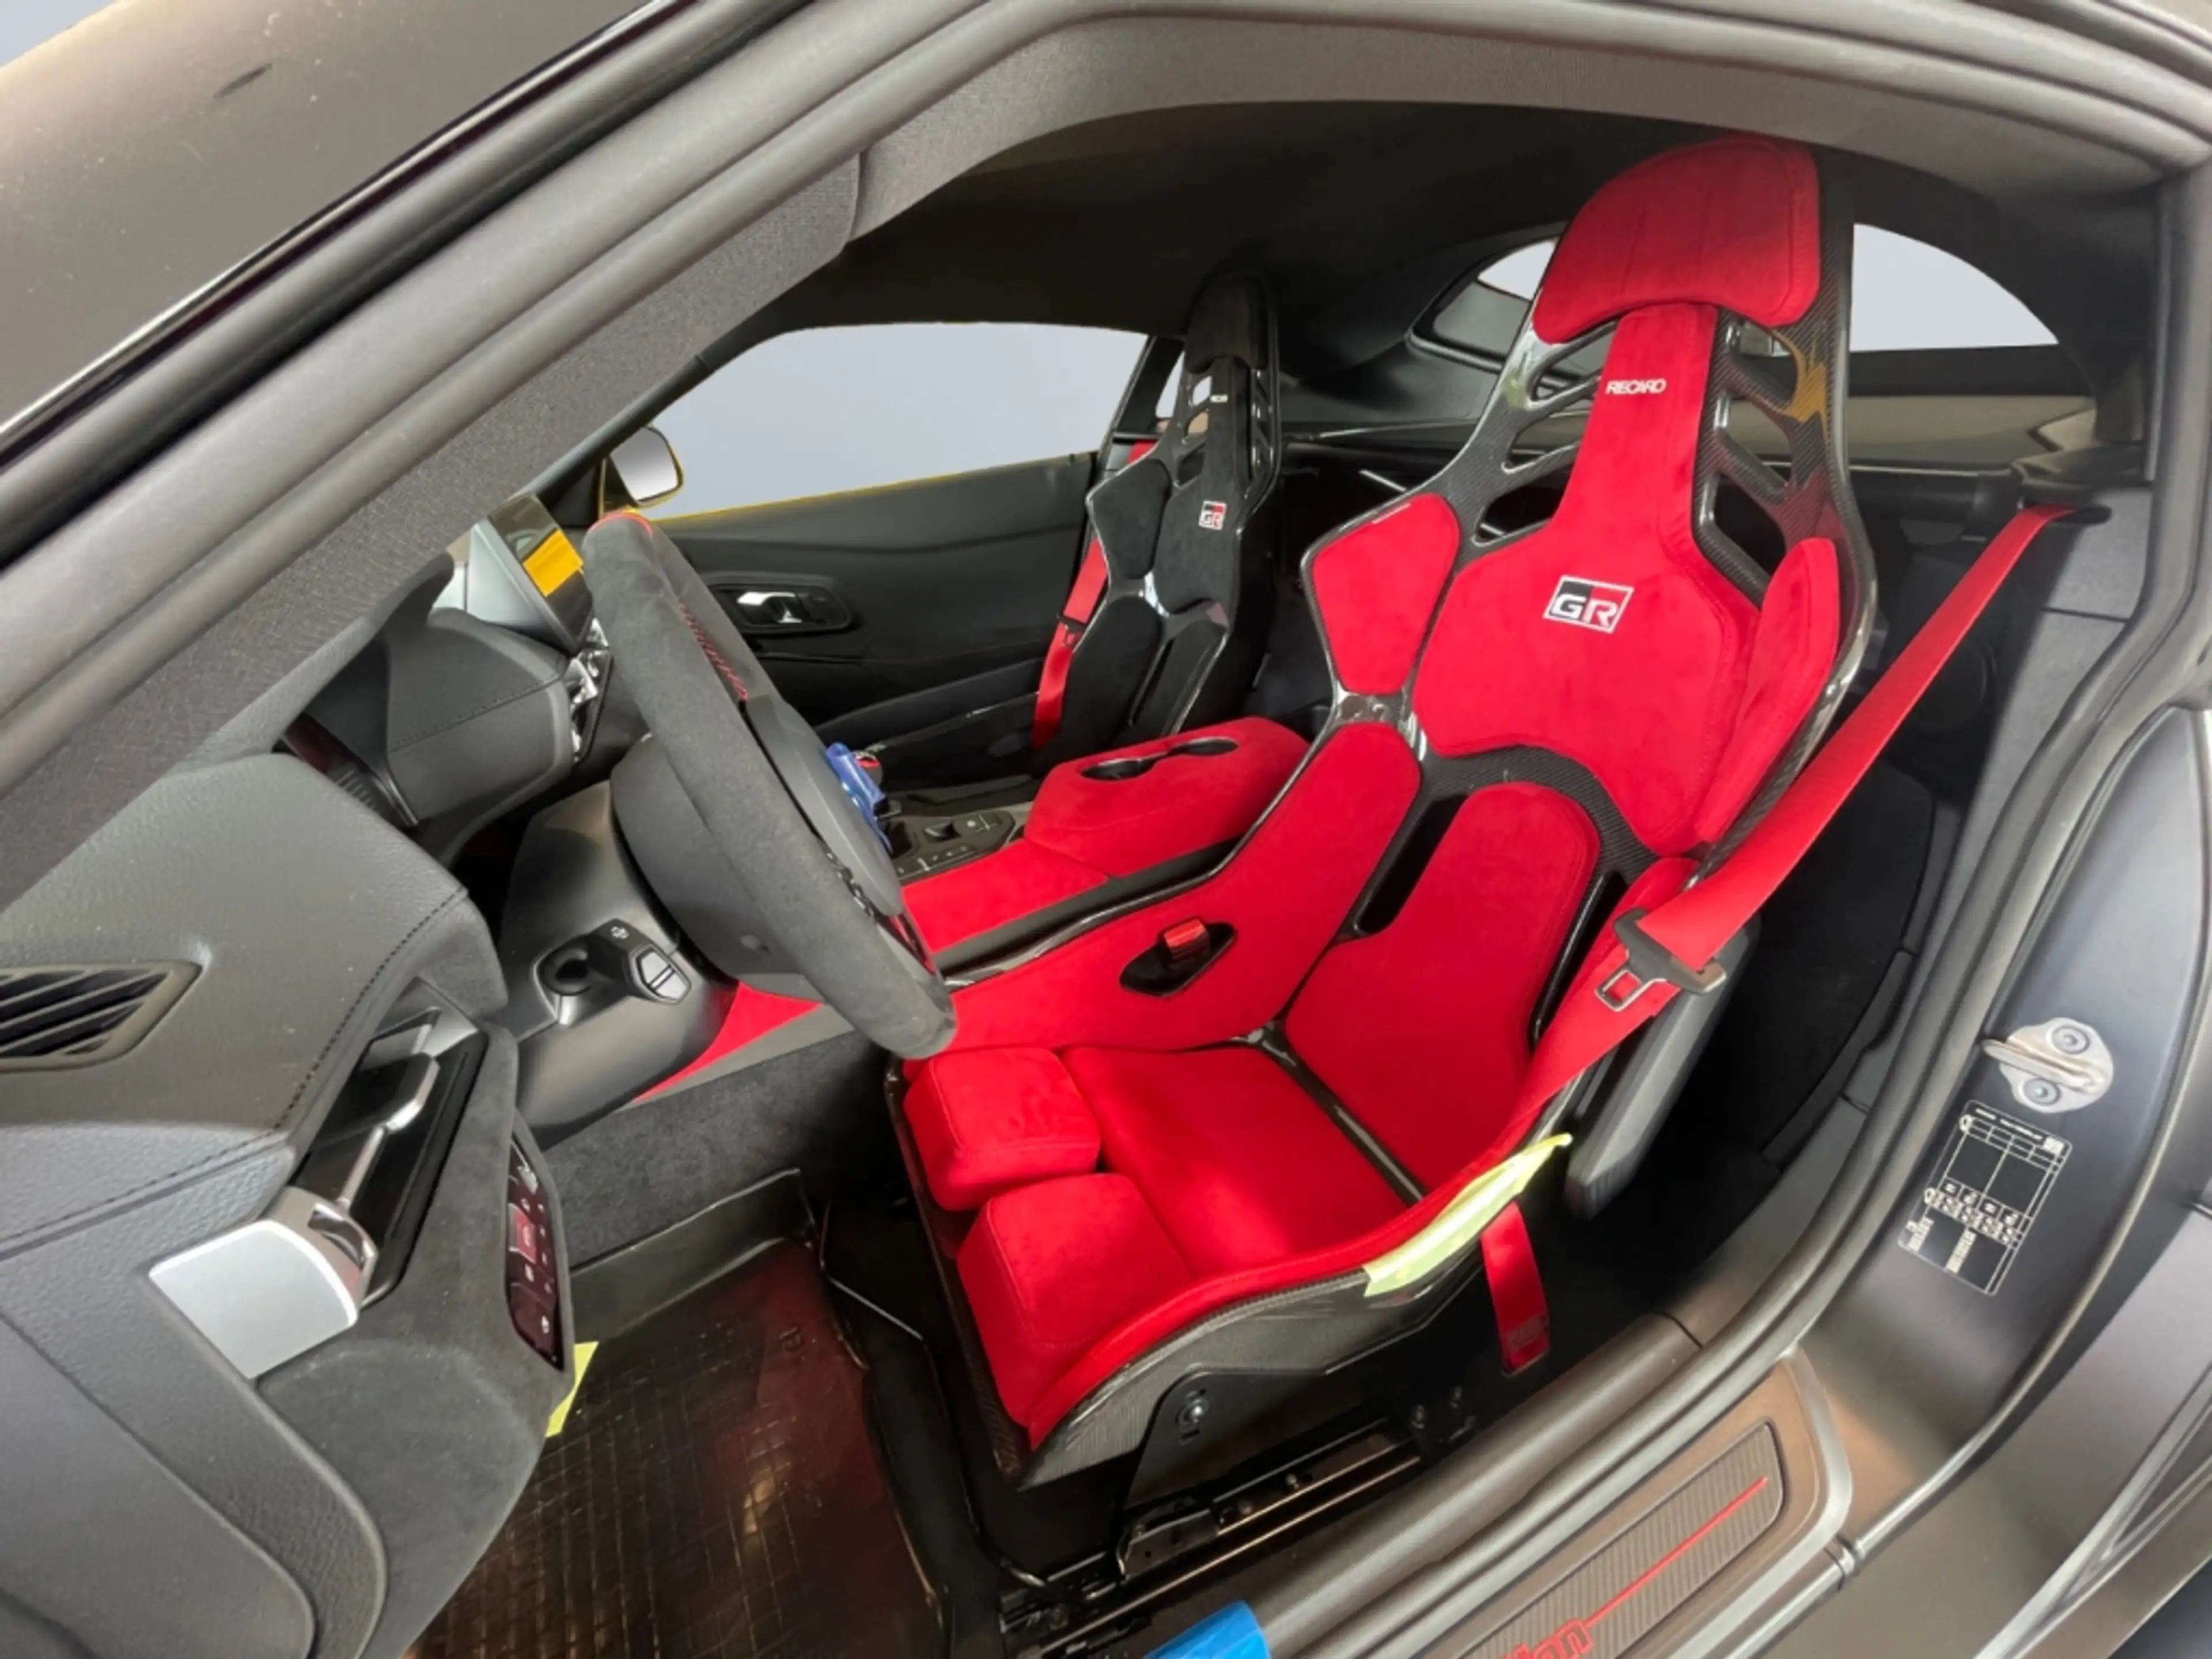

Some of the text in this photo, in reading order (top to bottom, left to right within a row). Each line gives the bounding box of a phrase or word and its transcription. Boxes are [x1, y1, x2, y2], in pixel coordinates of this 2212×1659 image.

[1605, 378, 1666, 395] RECARO
[1200, 510, 1223, 528] GR
[1551, 593, 1618, 628] GR
